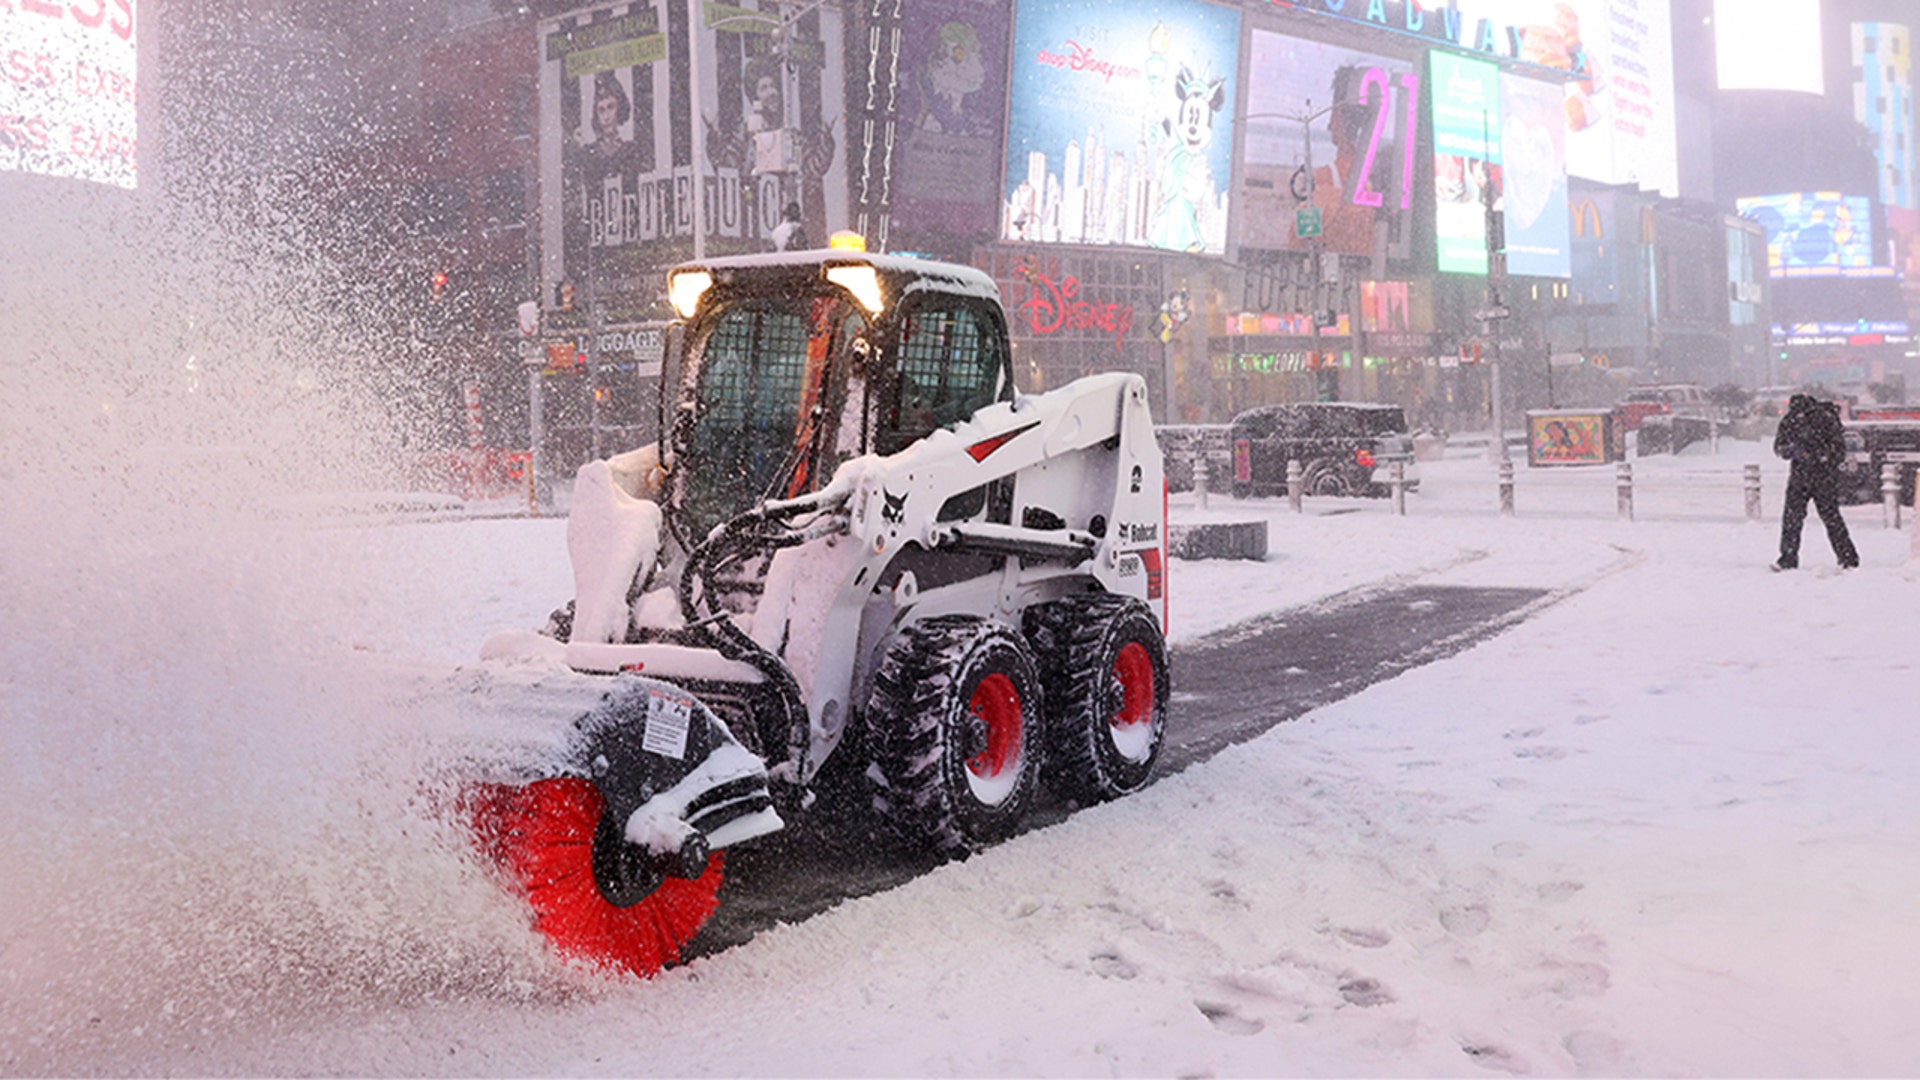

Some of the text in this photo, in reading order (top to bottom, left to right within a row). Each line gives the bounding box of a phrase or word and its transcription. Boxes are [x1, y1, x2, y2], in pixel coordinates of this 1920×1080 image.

[1353, 67, 1418, 209] 21
[589, 173, 802, 247] BEETLEJUIC
[1131, 523, 1157, 542] Bobcat
